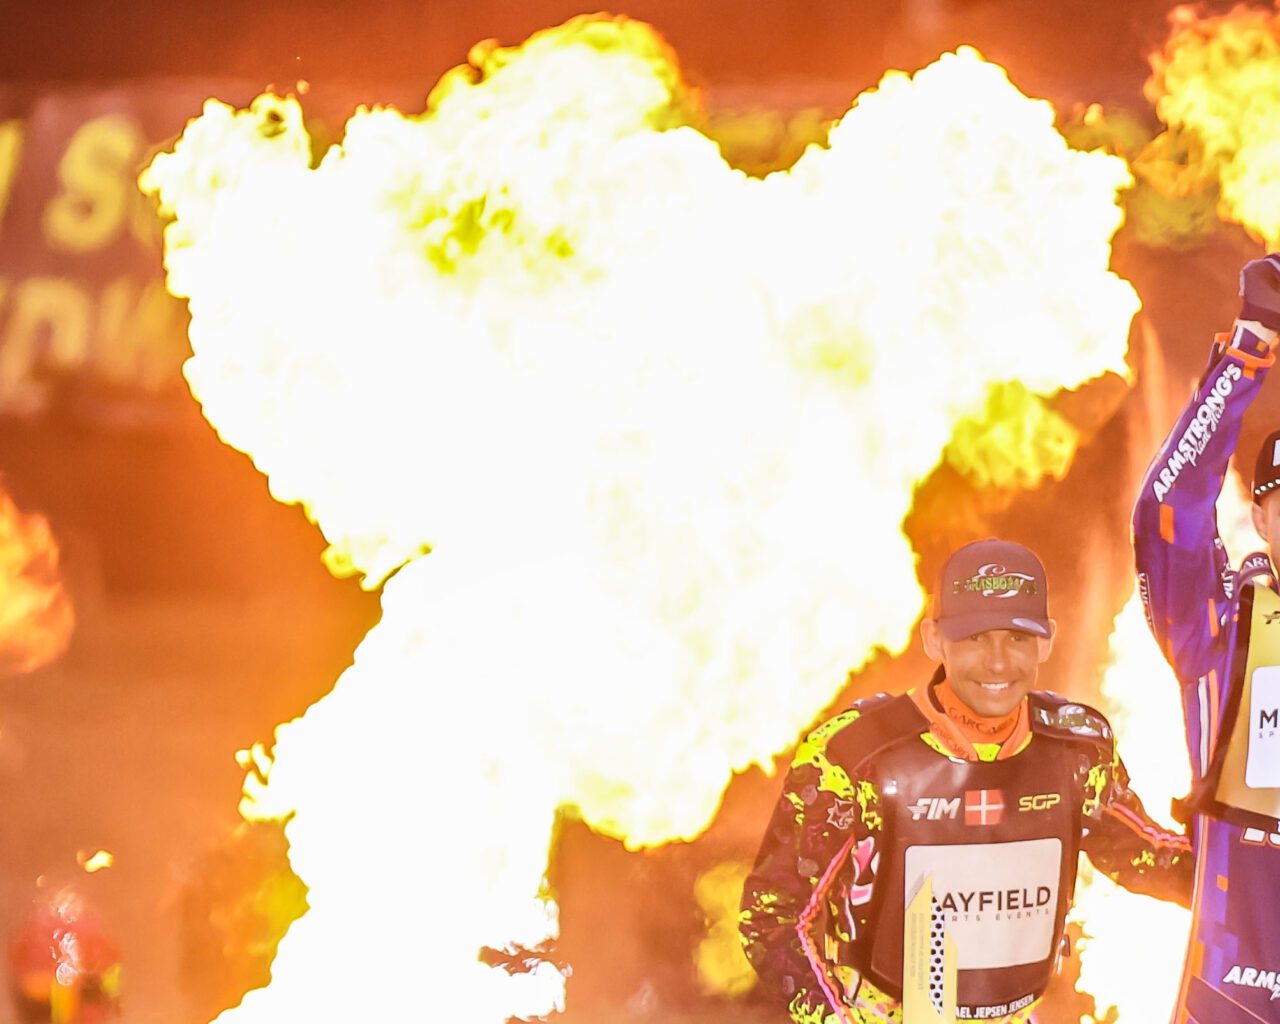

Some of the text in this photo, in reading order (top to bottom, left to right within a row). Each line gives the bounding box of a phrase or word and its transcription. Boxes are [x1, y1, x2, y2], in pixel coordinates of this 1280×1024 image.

[1152, 363, 1242, 503] ARMSTRONG'S
[907, 797, 962, 821] FIM
[1018, 793, 1061, 812] SGP
[942, 886, 1051, 913] AYFIELD
[973, 1004, 1008, 1018] JEPSEN
[1008, 993, 1034, 1013] JENSEN
